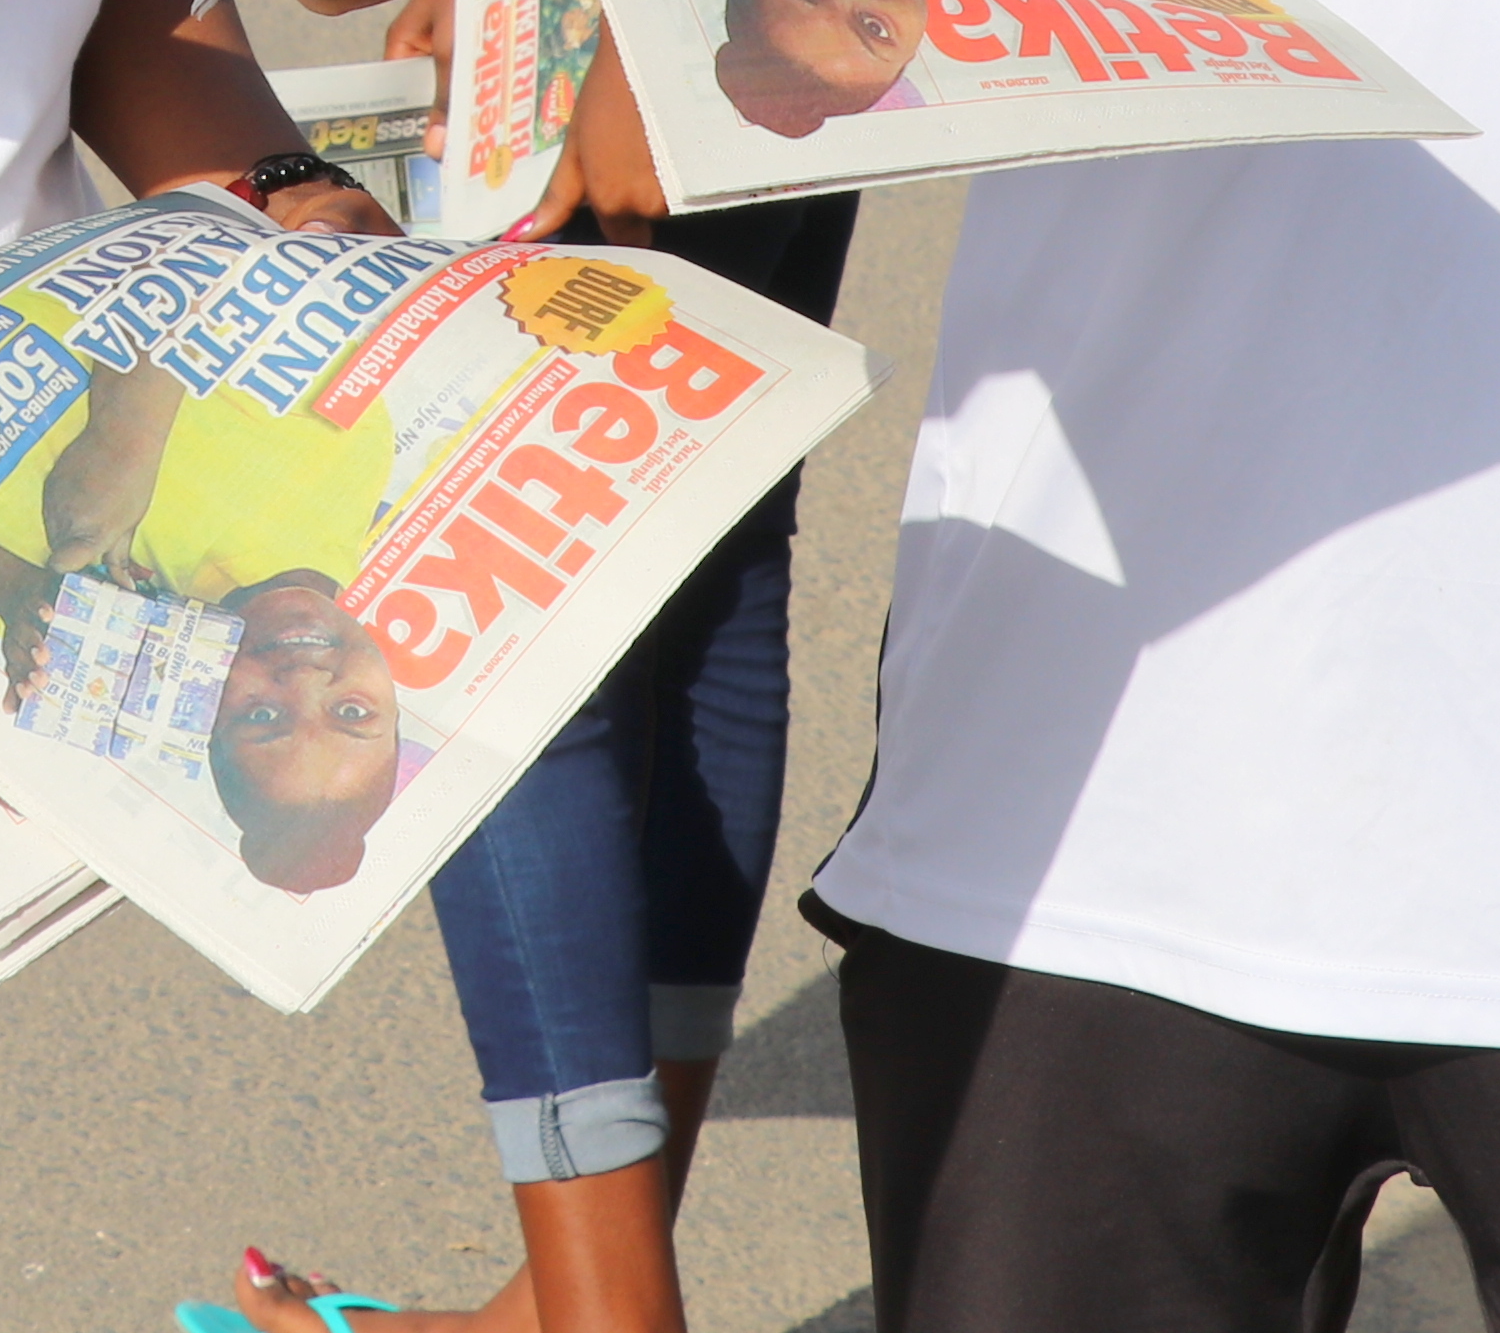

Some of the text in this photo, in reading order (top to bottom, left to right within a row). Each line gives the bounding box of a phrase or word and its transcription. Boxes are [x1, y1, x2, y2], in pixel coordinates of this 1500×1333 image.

[437, 263, 474, 291] ya
[534, 260, 643, 344] BURE
[235, 235, 454, 416] AMPUNI
[342, 361, 571, 611] Habari zote kuhusu Betting na Lotto
[624, 424, 688, 489] Bet kijanja
[639, 436, 702, 496] Pata zaidi,
[359, 320, 767, 696] Betika
